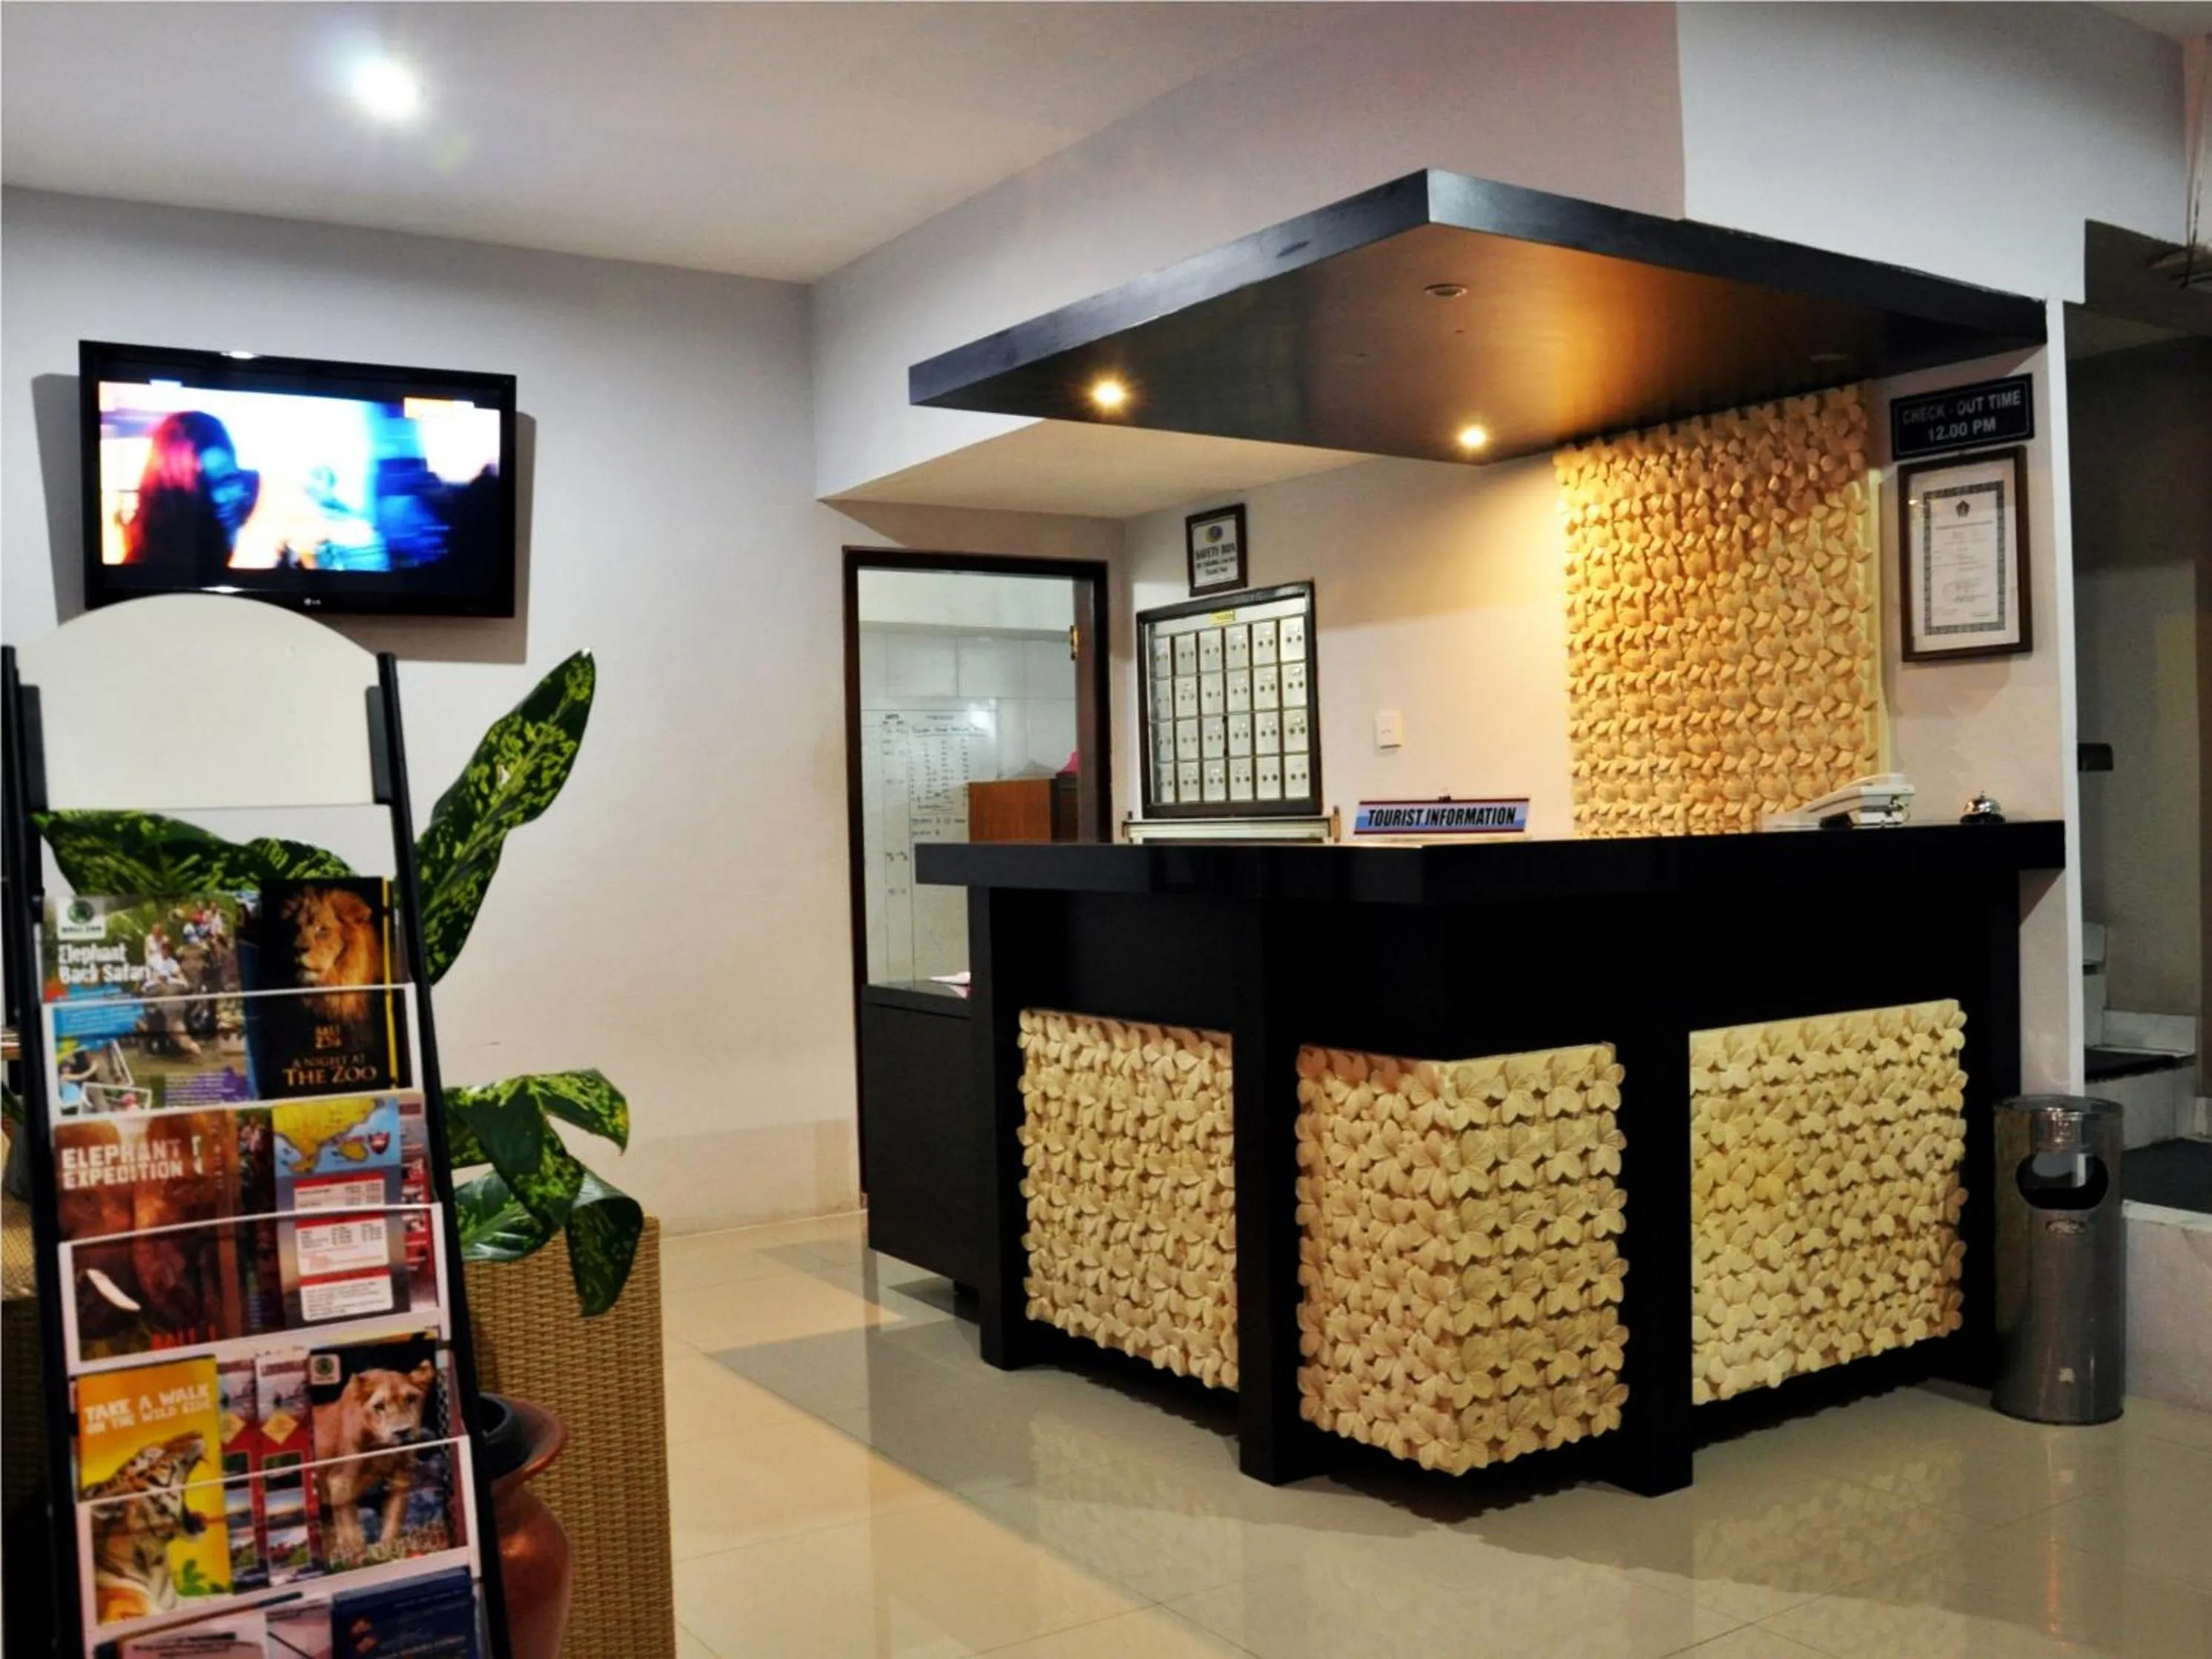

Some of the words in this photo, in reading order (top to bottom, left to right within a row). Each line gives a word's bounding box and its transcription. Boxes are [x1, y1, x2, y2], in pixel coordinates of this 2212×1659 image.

[1902, 404, 1946, 425] CHECK
[1956, 397, 1984, 416] OUT
[1988, 389, 2021, 409] TIME
[1928, 422, 1967, 443] 12.00
[1972, 417, 1996, 435] PM
[1367, 808, 1424, 826] TOURIST
[1424, 807, 1516, 826] INFORMATION
[58, 942, 128, 965] Elephant
[58, 963, 98, 985] Back
[303, 1055, 347, 1066] NIGHT
[350, 1052, 366, 1064] AT
[283, 1068, 328, 1087] THE
[331, 1066, 377, 1084] ZOO
[62, 1138, 182, 1170] ELEPHANT
[62, 1159, 184, 1190] EXPEDITION
[84, 1398, 132, 1422] TAKE
[138, 1395, 153, 1411] A
[157, 1382, 210, 1406] WALK
[141, 1405, 177, 1422] WILD
